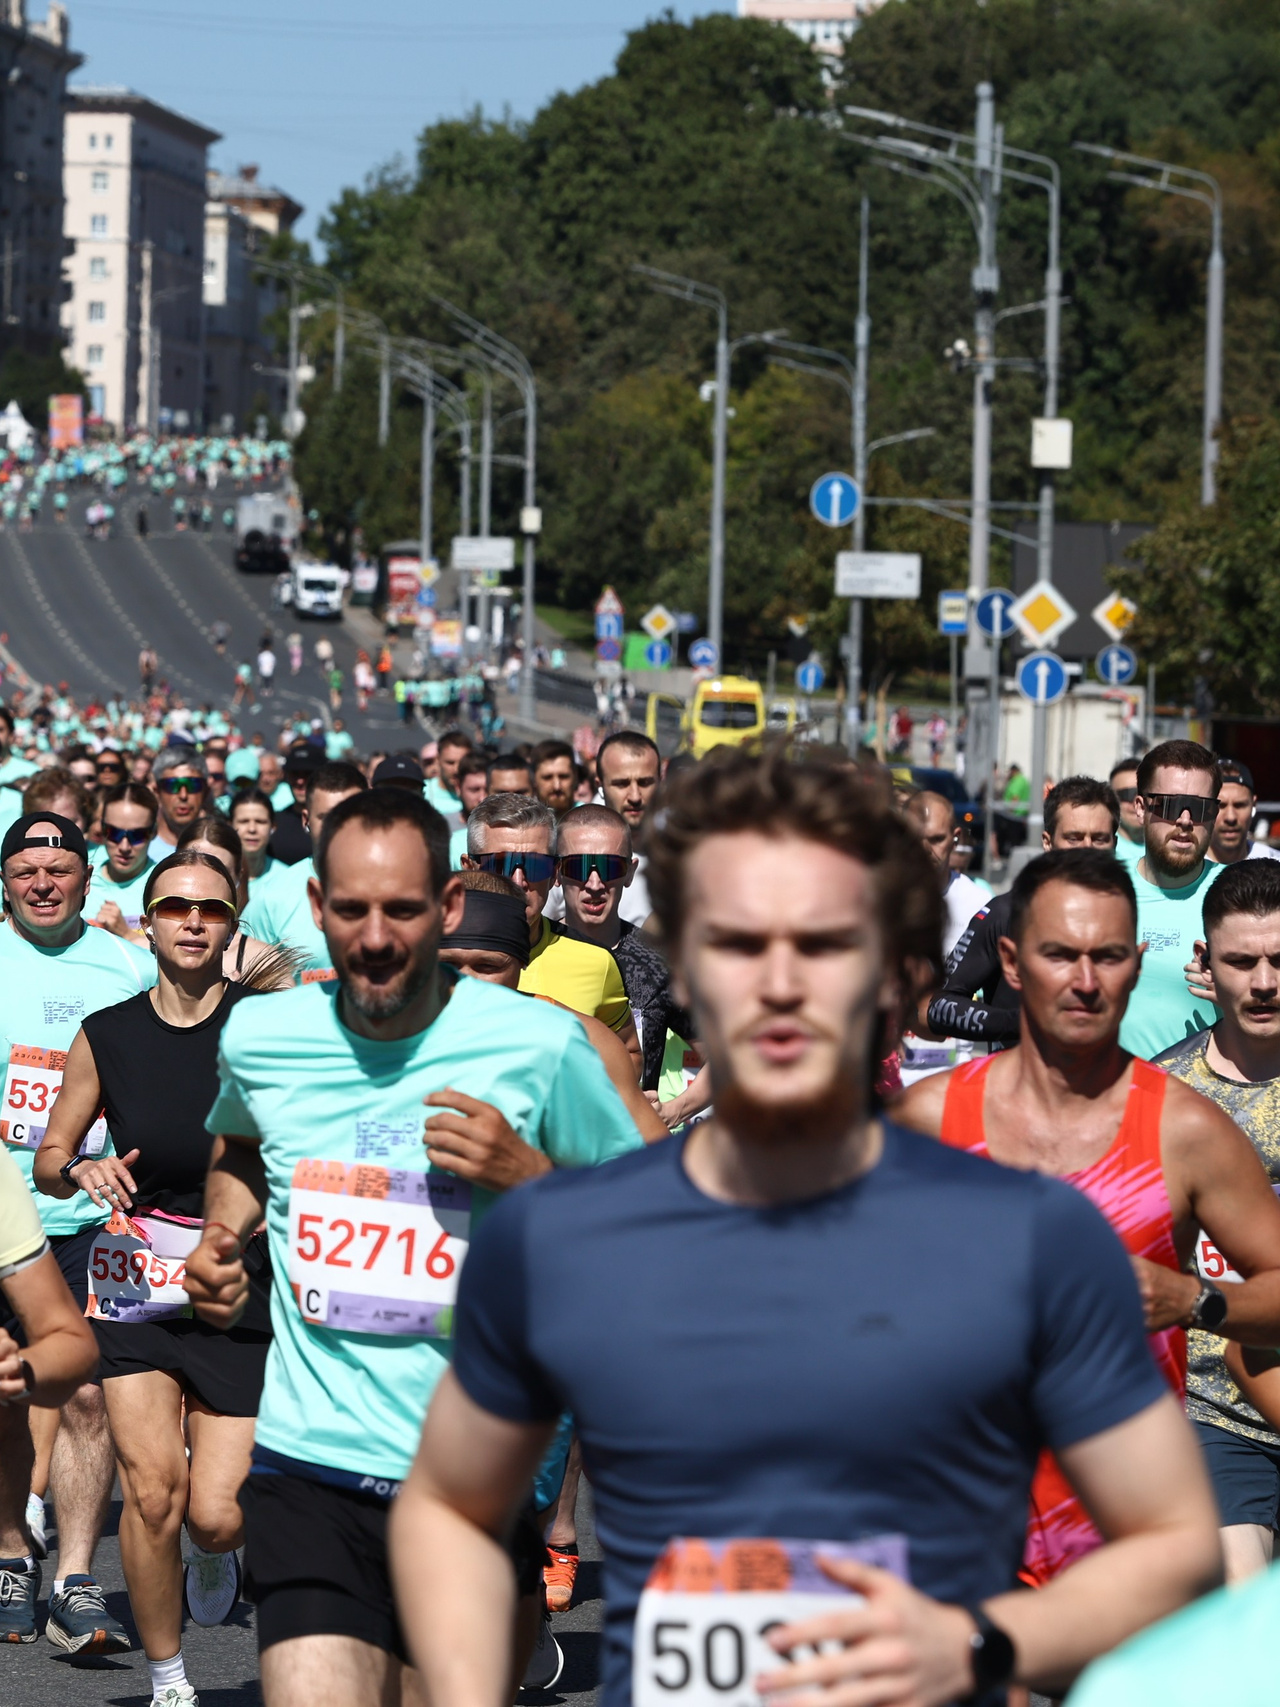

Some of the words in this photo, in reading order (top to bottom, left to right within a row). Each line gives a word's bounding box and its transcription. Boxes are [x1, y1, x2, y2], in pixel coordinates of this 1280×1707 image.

[15, 1052, 43, 1061] 23/08
[297, 1213, 455, 1280] 52716
[92, 1247, 187, 1290] 53954
